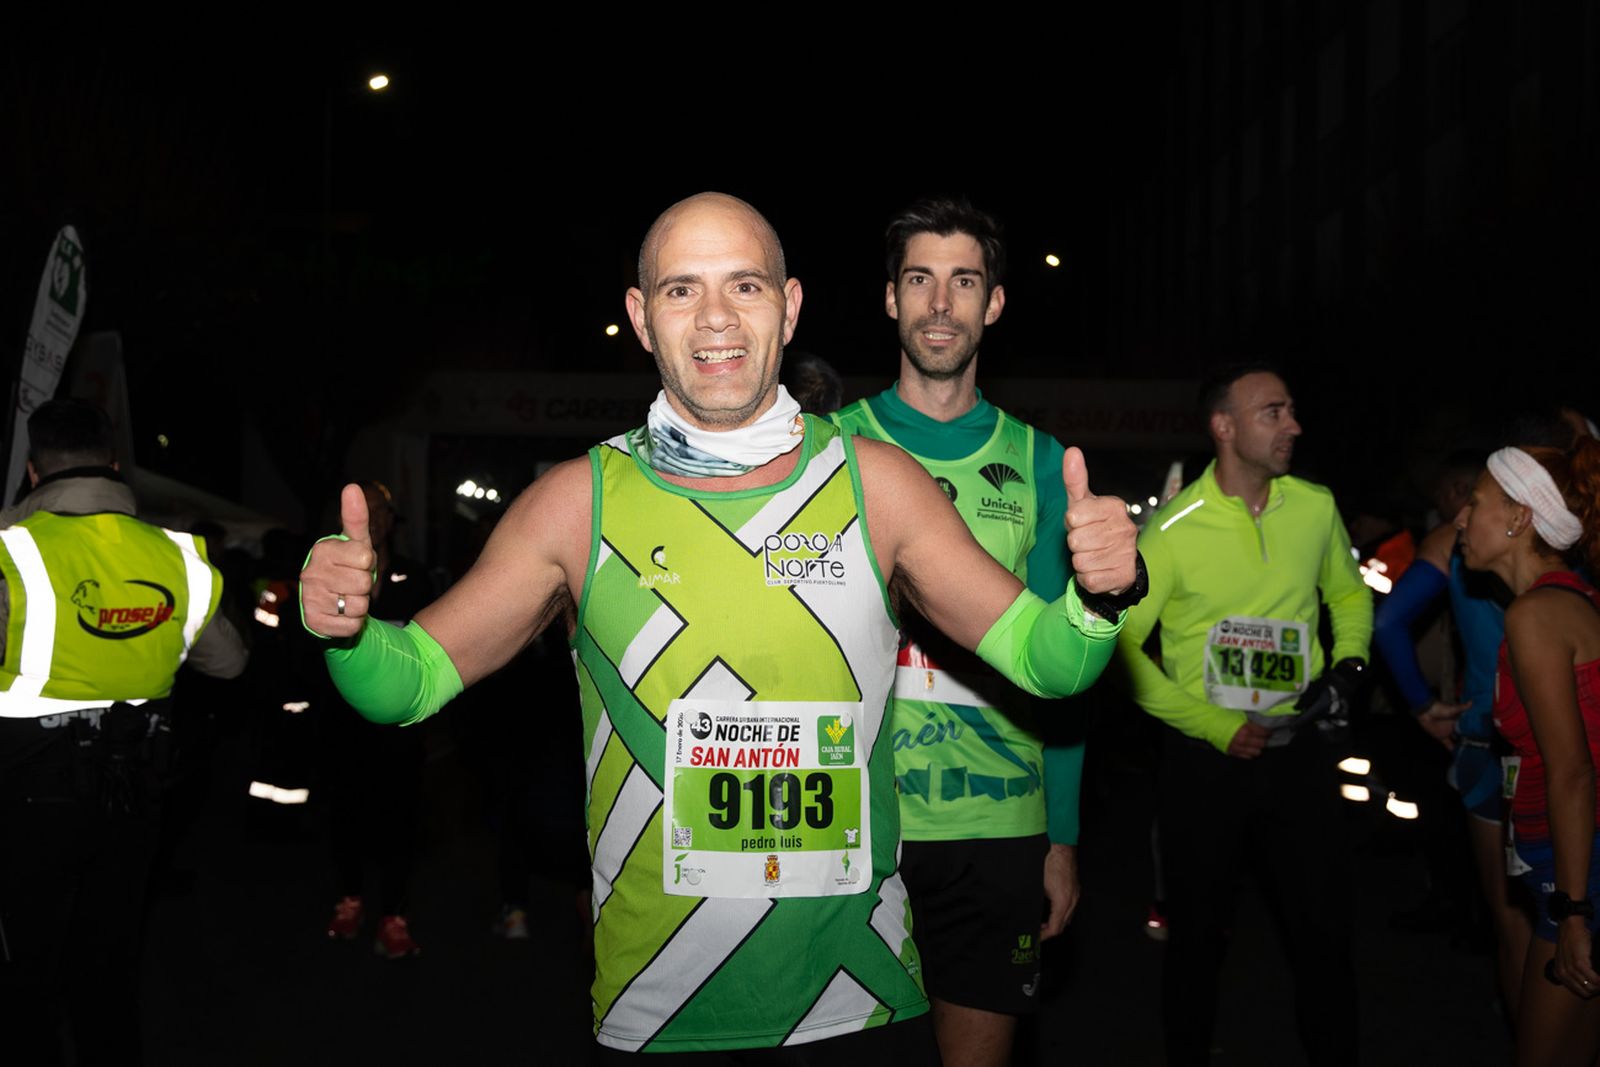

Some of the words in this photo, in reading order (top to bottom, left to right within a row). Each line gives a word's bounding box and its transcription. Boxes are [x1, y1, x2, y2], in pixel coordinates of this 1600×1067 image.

[981, 497, 1023, 514] Unicaja
[639, 572, 681, 586] AIMAR
[1218, 648, 1296, 682] 13429
[715, 724, 774, 742] NOCHE
[777, 725, 800, 742] DE
[892, 712, 963, 751] aén
[690, 746, 730, 767] SAN
[733, 743, 800, 768] ANTÓN
[708, 772, 834, 831] 9193
[741, 836, 776, 852] pedro
[780, 835, 802, 849] luis
